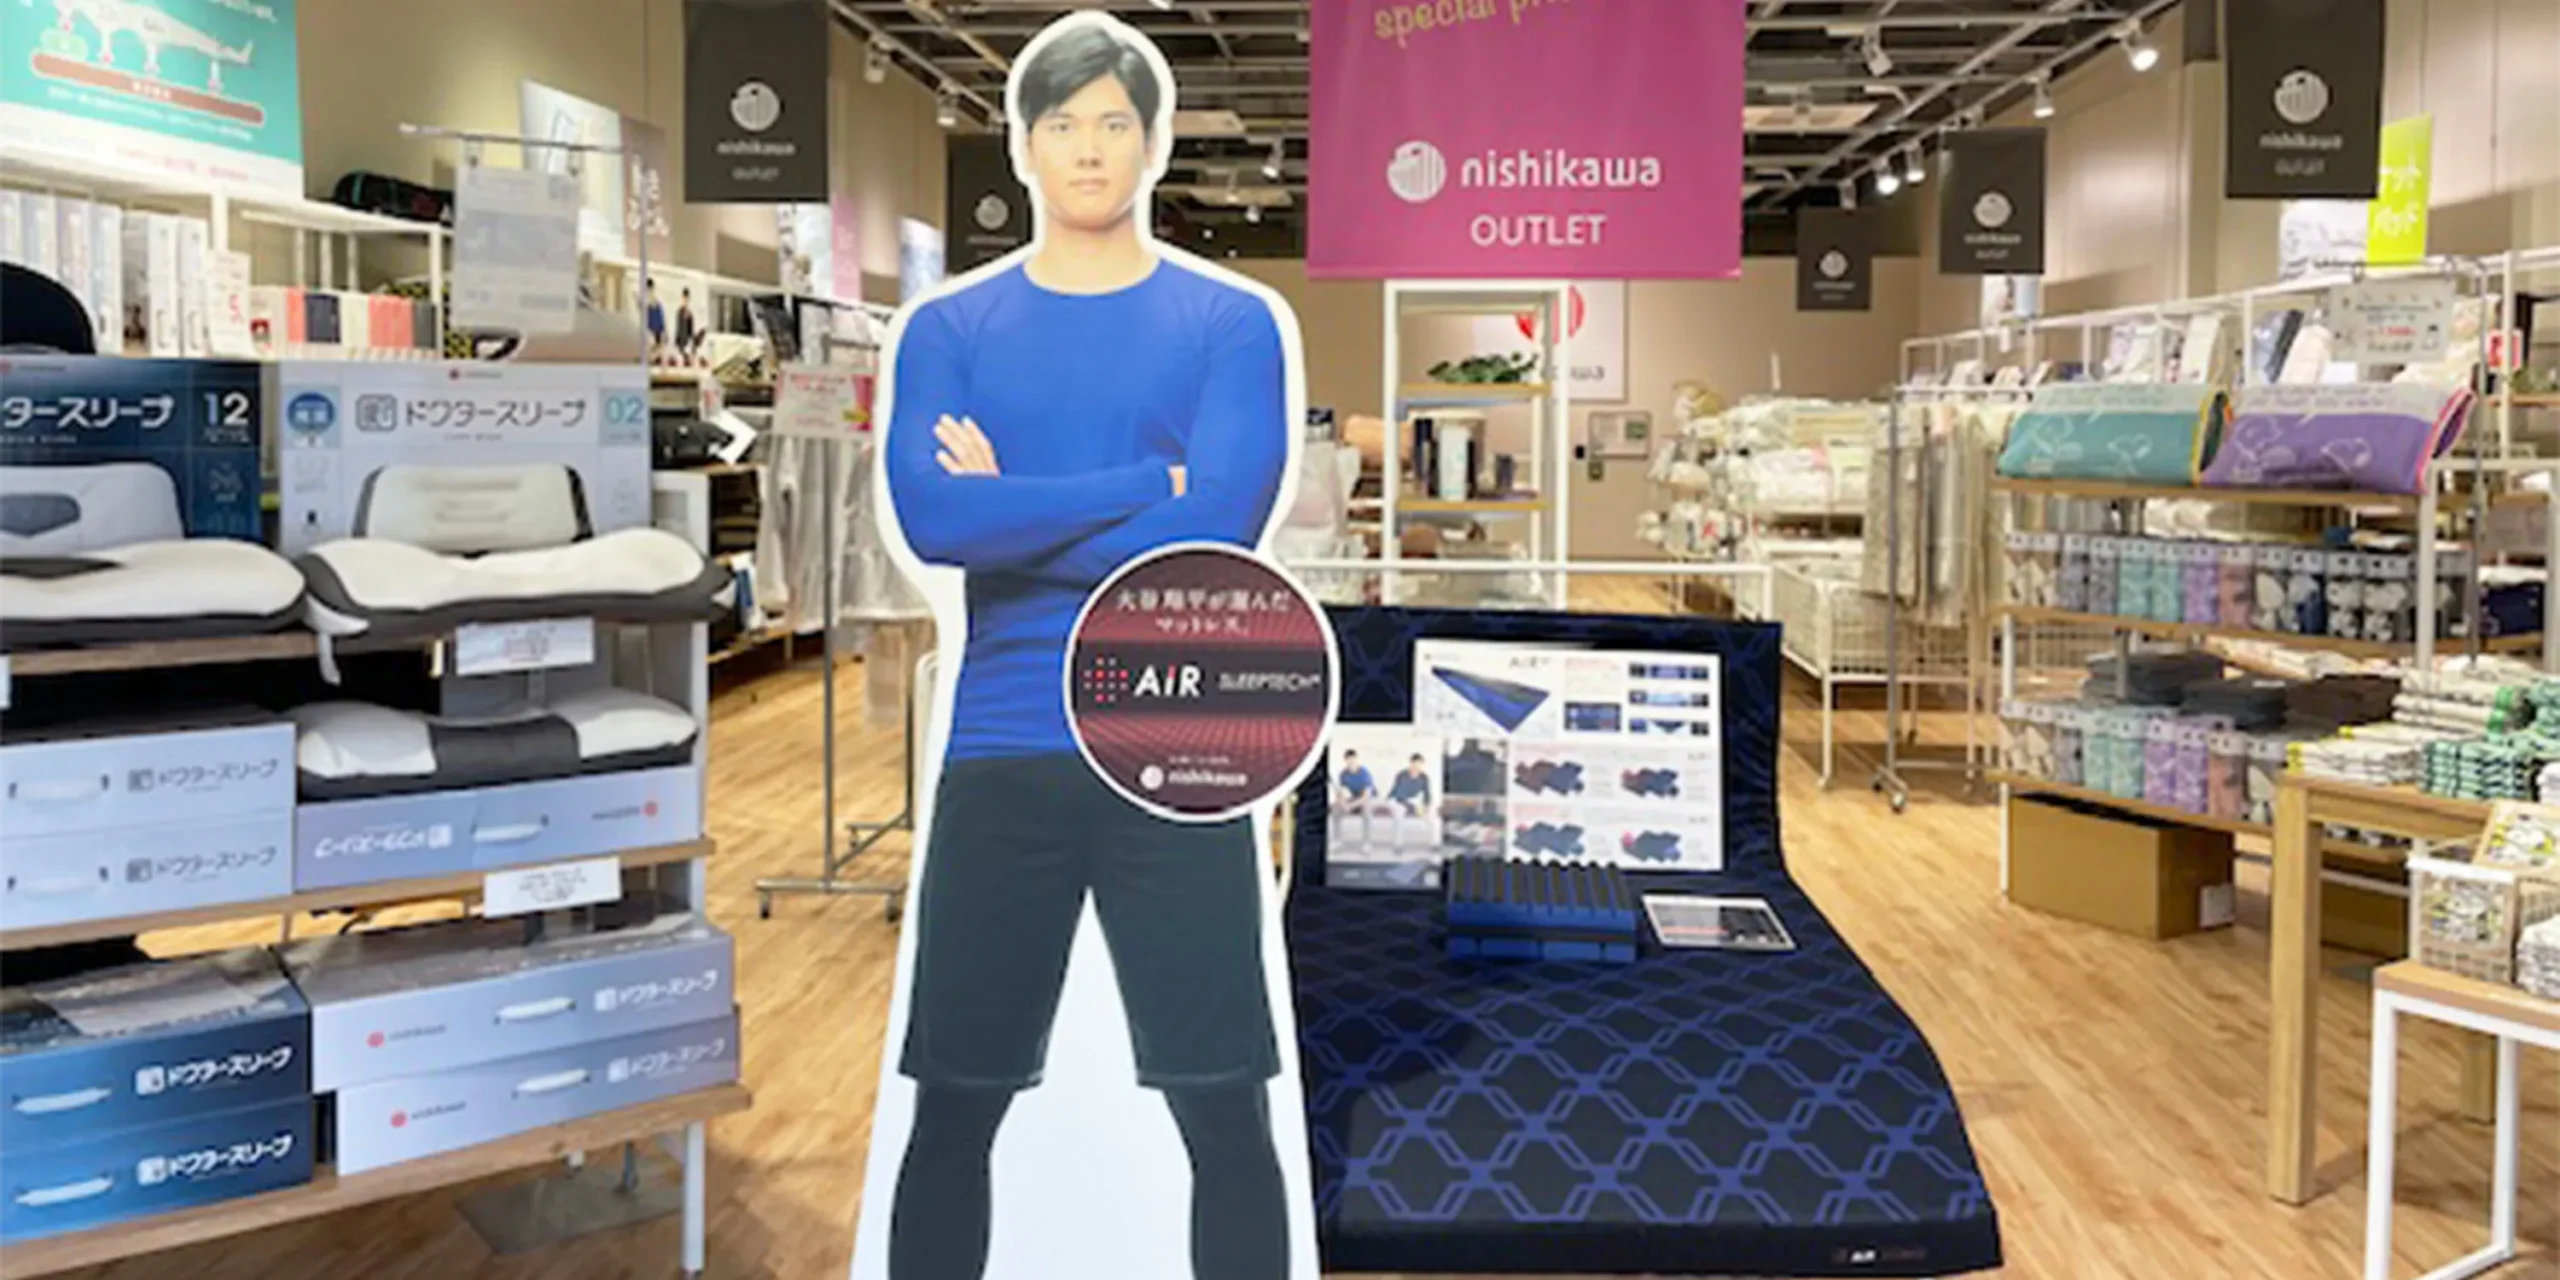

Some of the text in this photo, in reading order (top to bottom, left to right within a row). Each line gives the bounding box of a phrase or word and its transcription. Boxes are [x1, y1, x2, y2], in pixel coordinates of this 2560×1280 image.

[1461, 150, 1661, 187] nishikawa
[1470, 213, 1606, 247] OUTLET
[204, 390, 249, 426] 12
[406, 400, 586, 428] ドクタースリープ
[604, 395, 644, 426] 02
[1134, 664, 1202, 697] AiR
[168, 1045, 293, 1087] ドクタースリープ
[169, 1133, 293, 1176] ドクタースリープ
